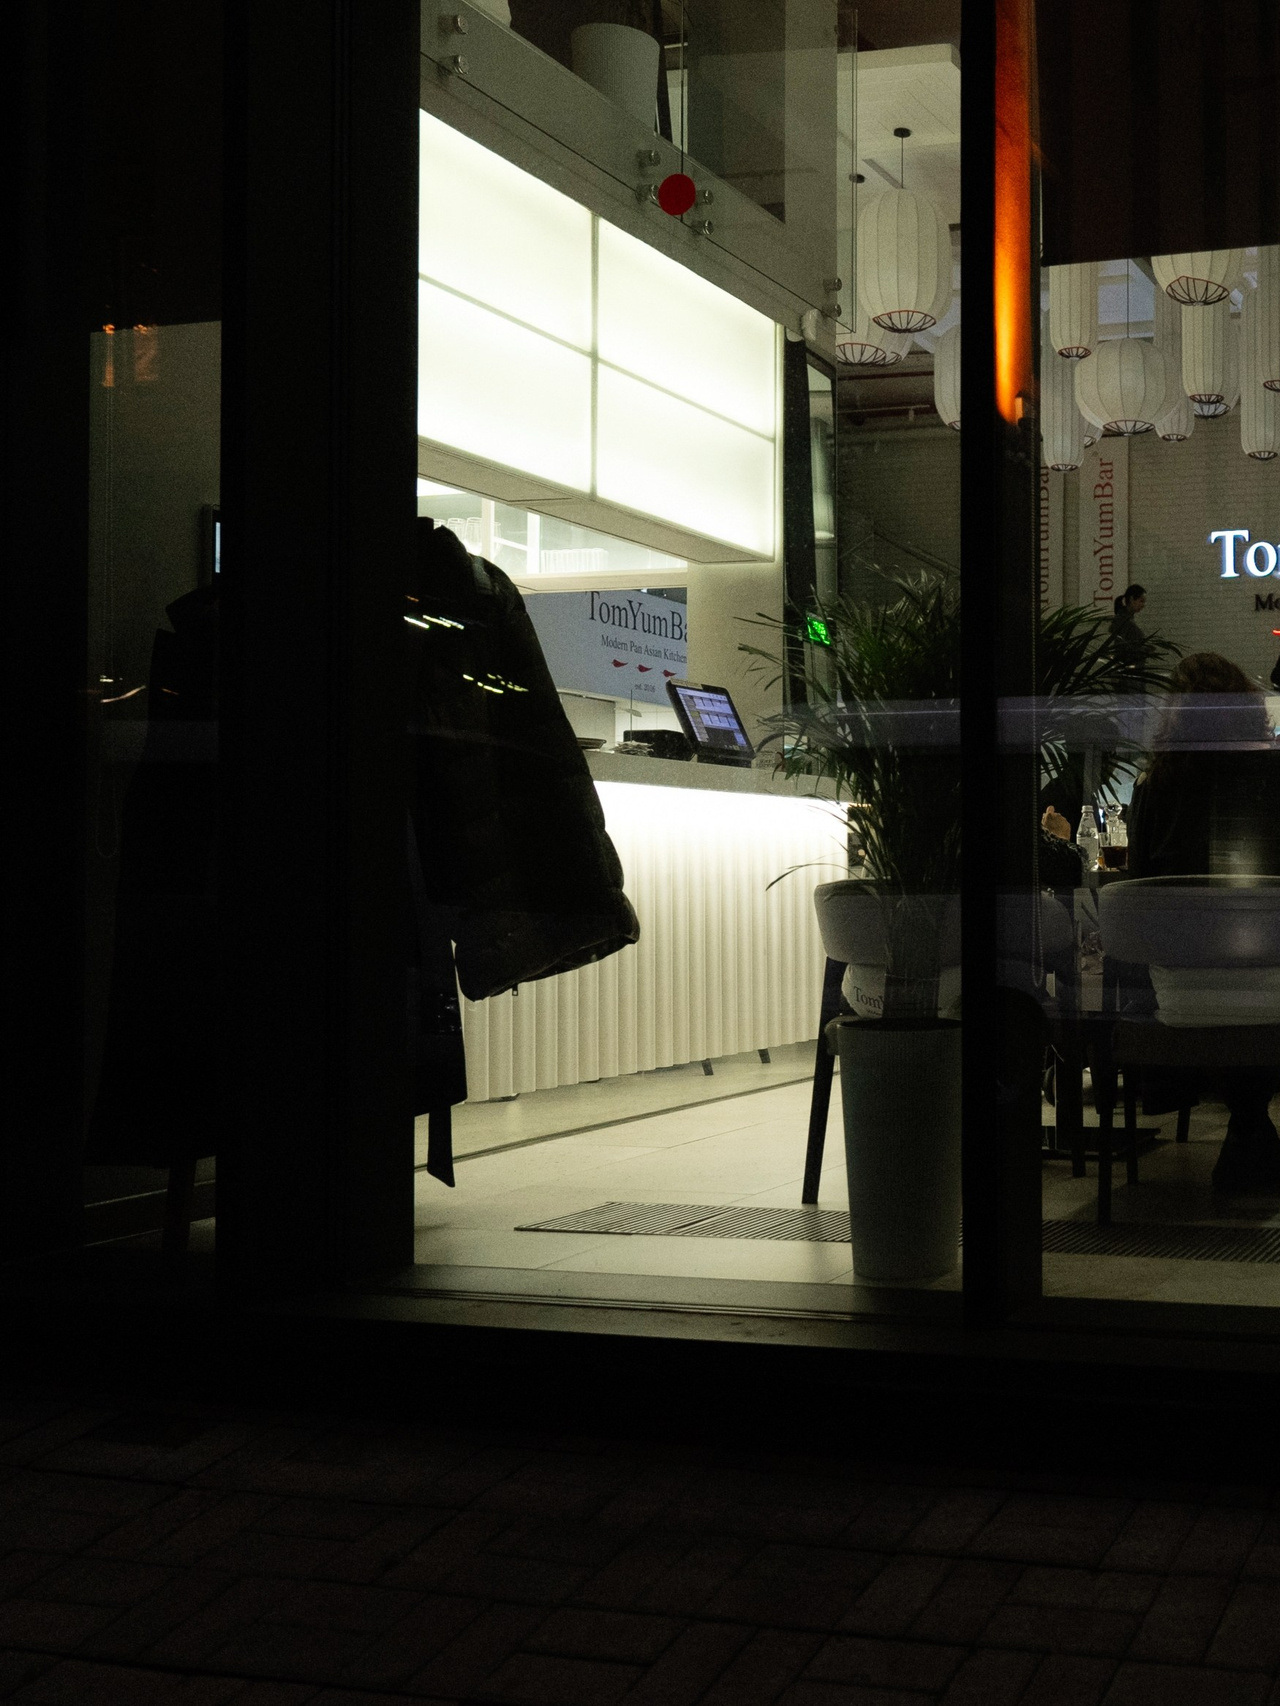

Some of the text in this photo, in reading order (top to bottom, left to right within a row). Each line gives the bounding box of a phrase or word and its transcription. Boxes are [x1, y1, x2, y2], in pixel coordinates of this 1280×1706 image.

[1094, 458, 1114, 608] TomYumBar
[601, 634, 629, 652] Modern
[630, 640, 643, 655] Pan
[644, 644, 662, 658] Asian
